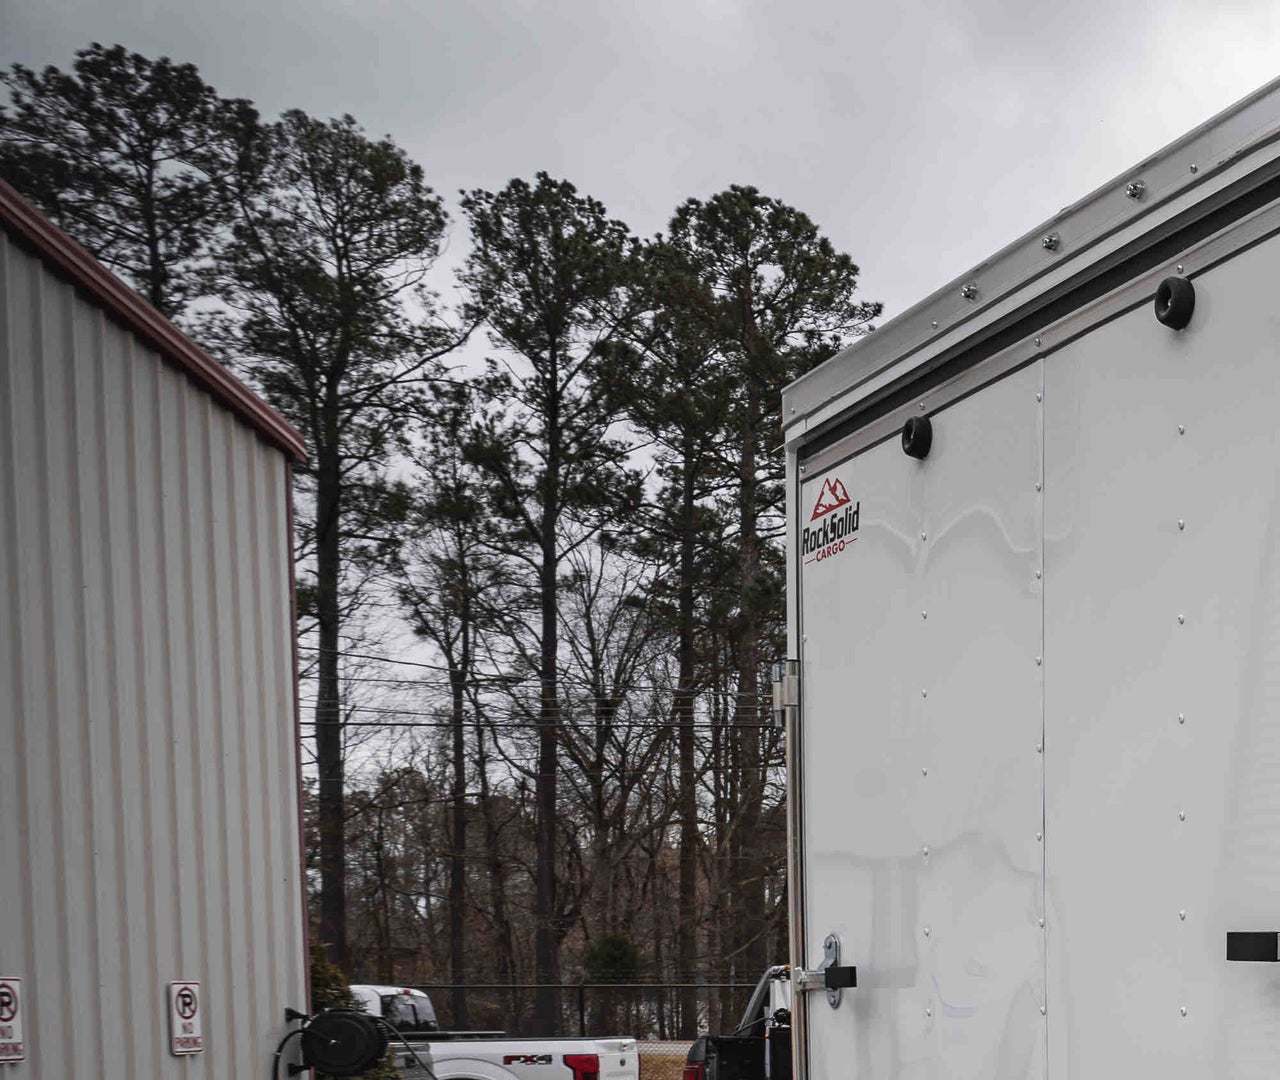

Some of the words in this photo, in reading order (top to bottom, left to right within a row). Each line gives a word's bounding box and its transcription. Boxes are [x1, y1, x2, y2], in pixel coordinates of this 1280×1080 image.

[802, 501, 860, 557] RockSolid
[815, 539, 846, 562] CARGO
[182, 1022, 194, 1034] NO
[174, 1037, 202, 1048] PARKING
[503, 1054, 553, 1066] FX4
